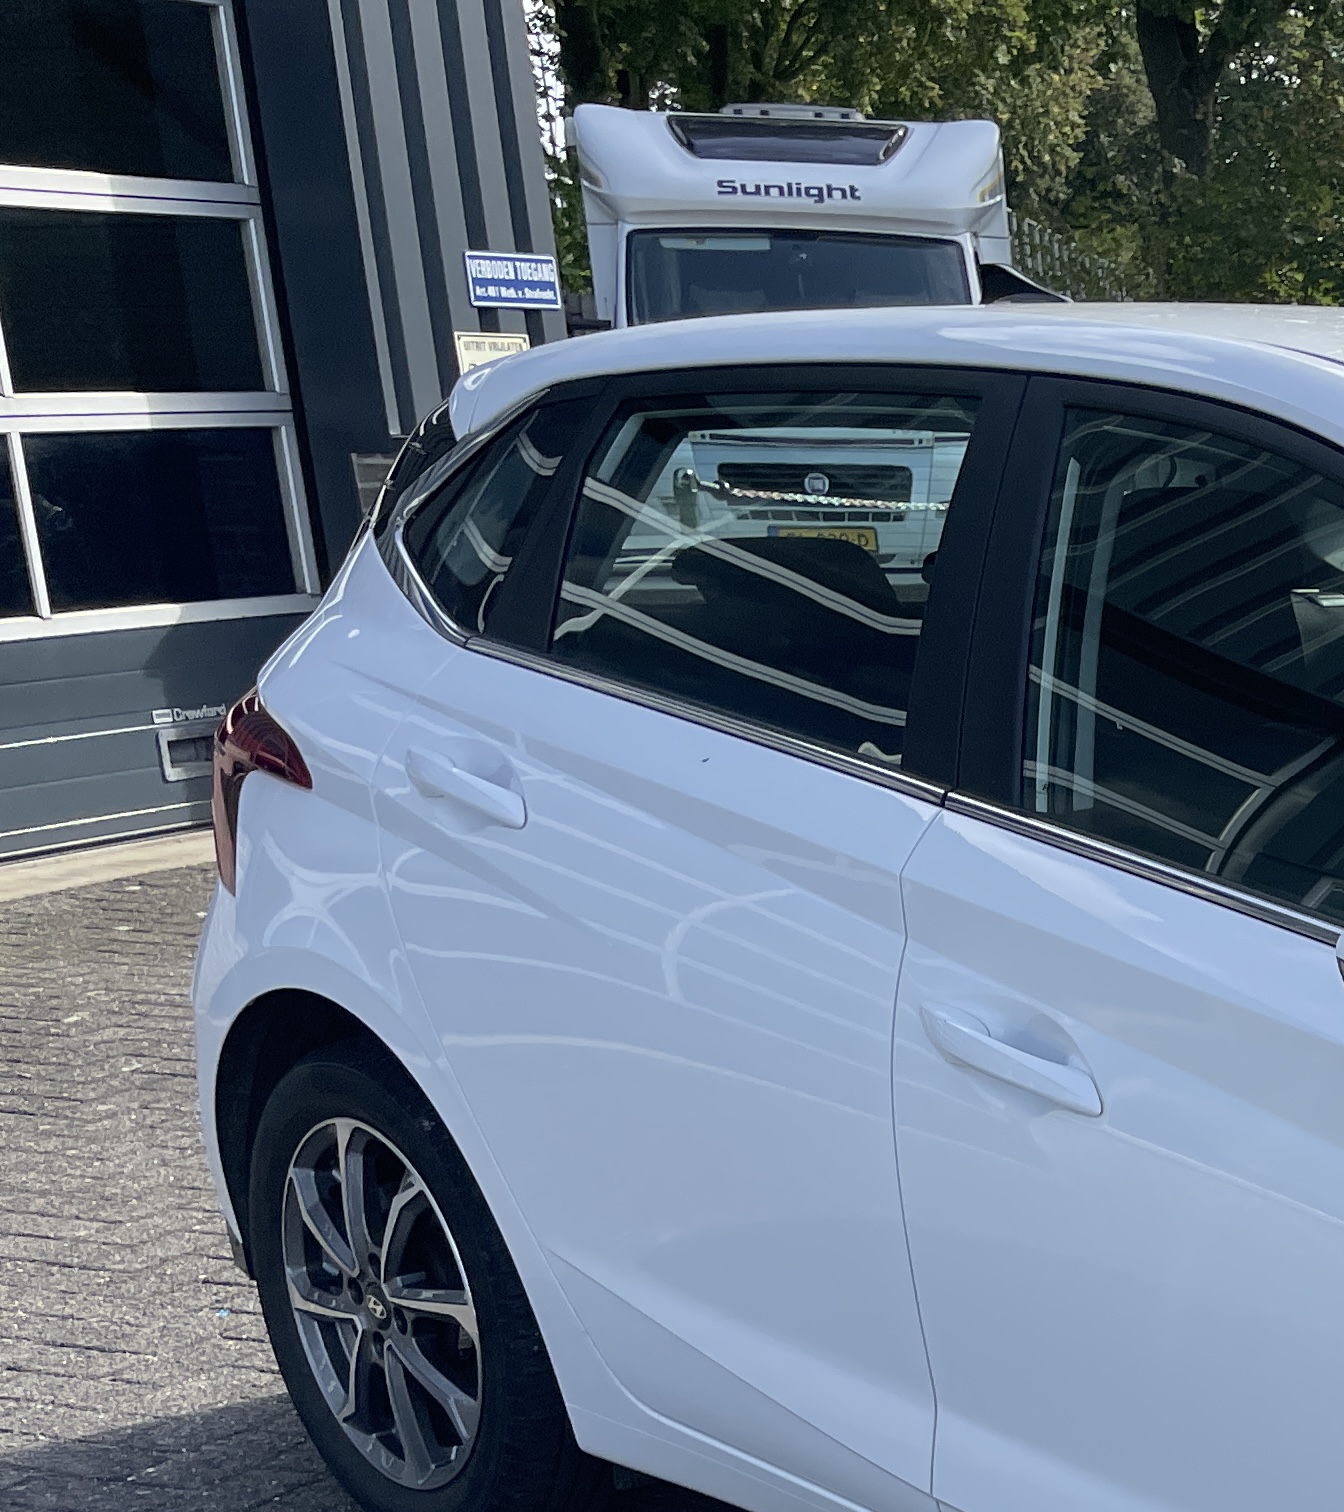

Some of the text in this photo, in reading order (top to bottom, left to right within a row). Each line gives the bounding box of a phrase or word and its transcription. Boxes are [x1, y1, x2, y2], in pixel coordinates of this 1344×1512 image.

[717, 179, 861, 204] Sunlight
[469, 259, 555, 282] VERBODEN TOEGANG
[173, 703, 227, 722] Crawford
